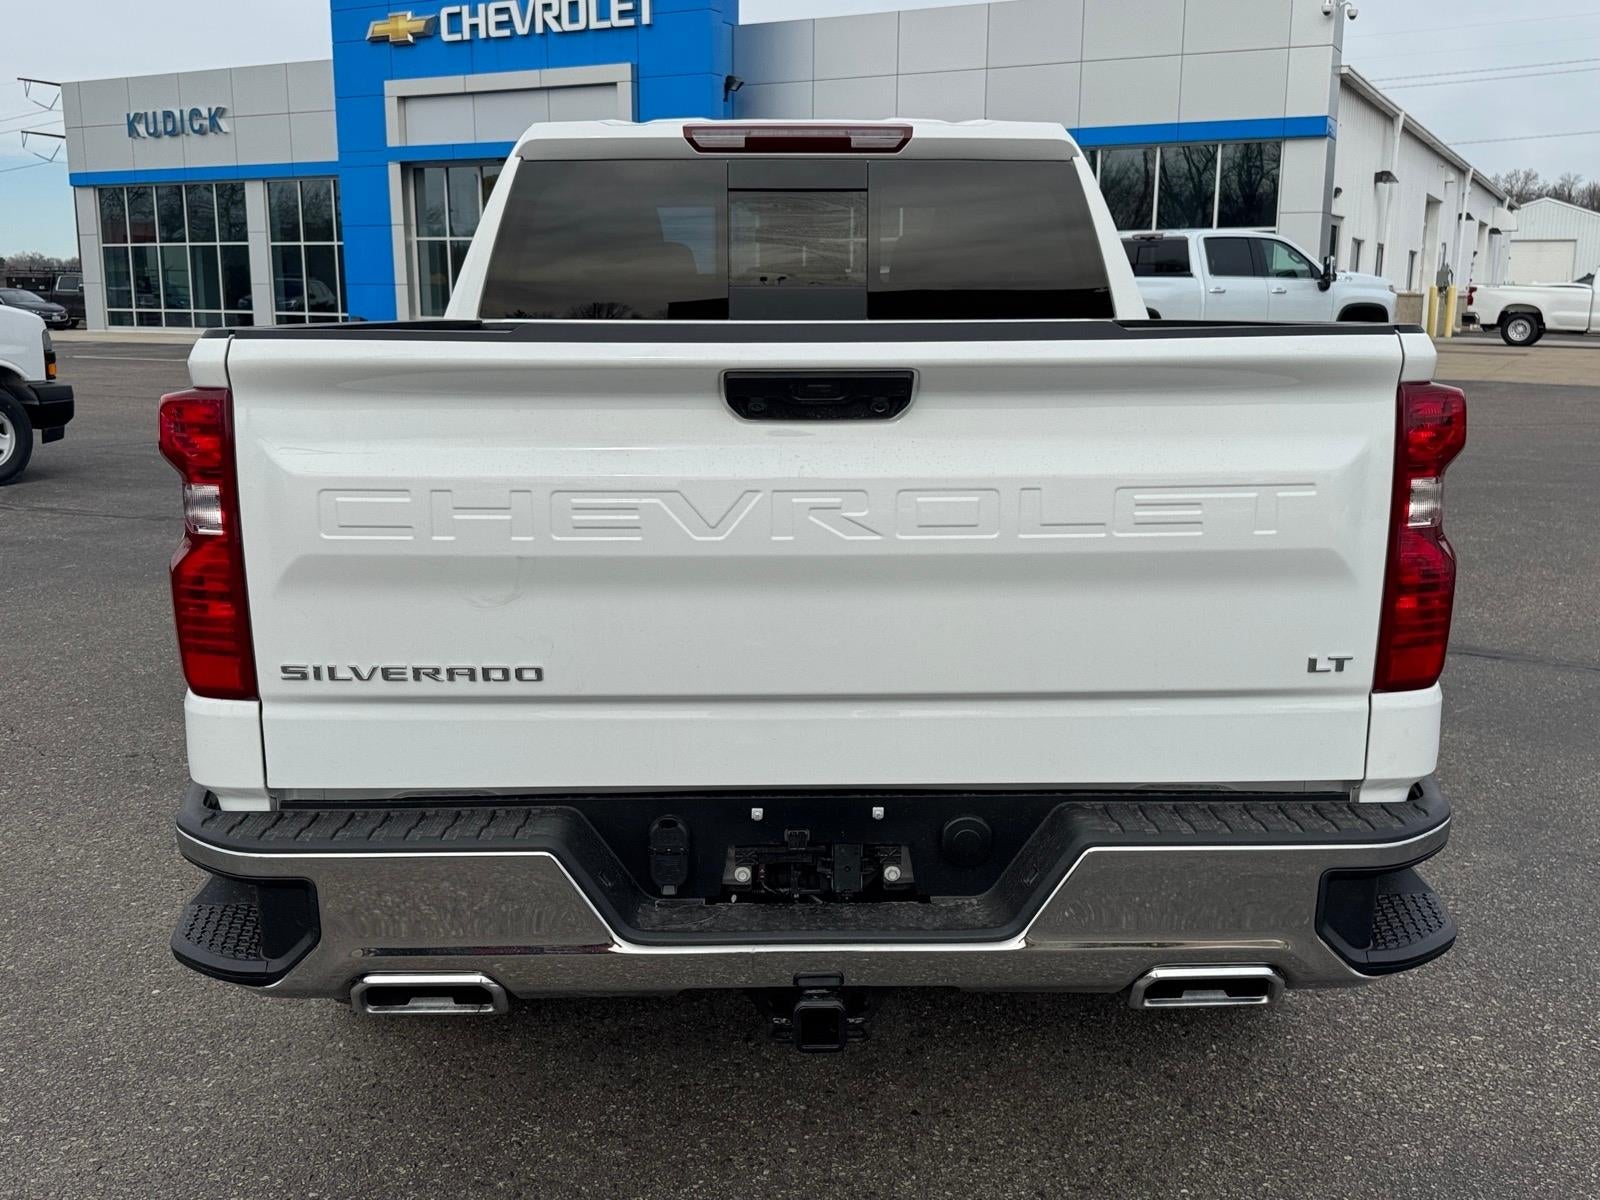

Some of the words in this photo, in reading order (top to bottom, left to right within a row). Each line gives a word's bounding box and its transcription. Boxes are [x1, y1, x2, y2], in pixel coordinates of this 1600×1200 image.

[126, 106, 230, 139] KUDICK
[318, 483, 1317, 541] CHEVROLET
[280, 664, 544, 682] SILVERADO
[1307, 656, 1353, 673] LT
